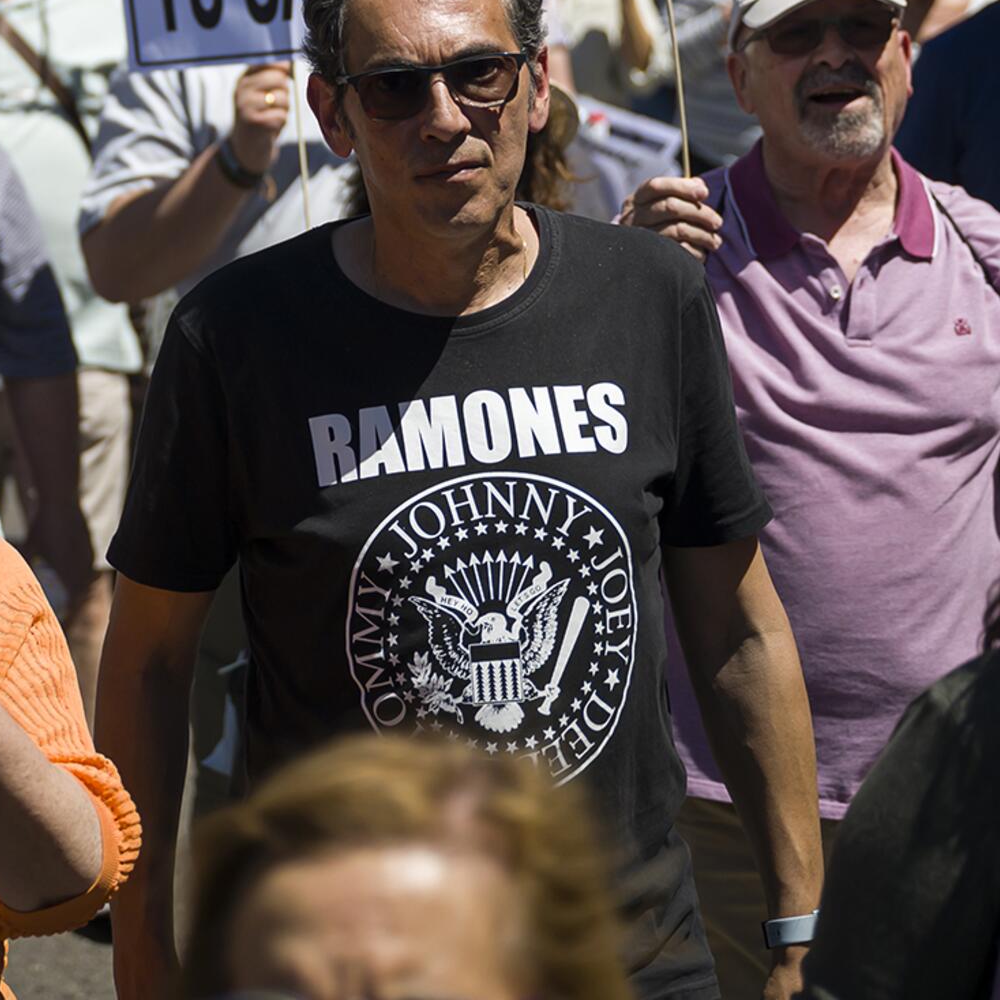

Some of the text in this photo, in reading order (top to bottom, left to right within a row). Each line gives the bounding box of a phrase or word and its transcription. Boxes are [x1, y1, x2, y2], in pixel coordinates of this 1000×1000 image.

[308, 382, 629, 488] RAMONES
[388, 481, 592, 559] JOHNNY
[352, 570, 412, 732] OMMY
[590, 546, 632, 666] JOEY
[541, 689, 617, 778] DEE
